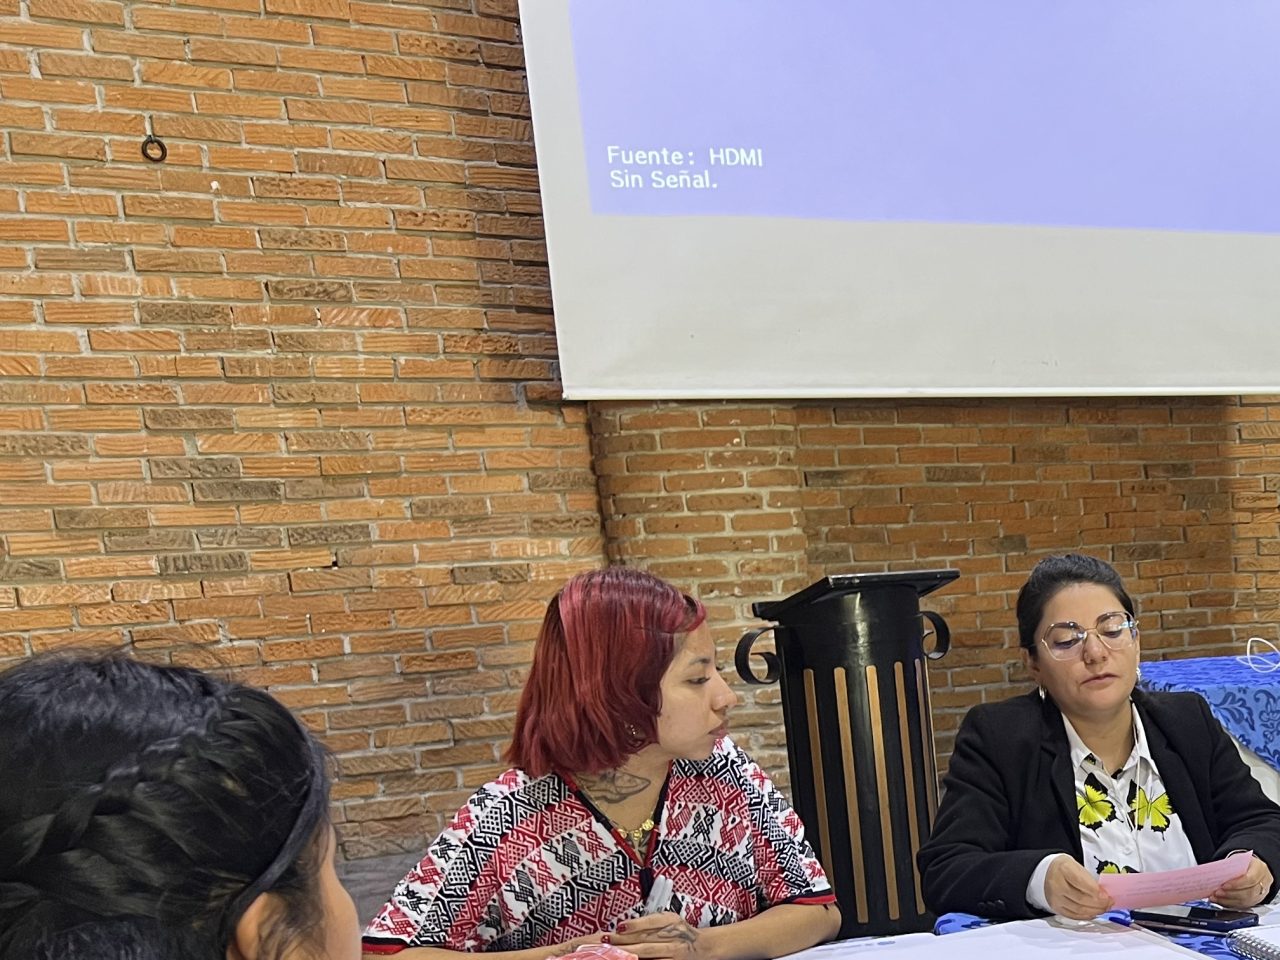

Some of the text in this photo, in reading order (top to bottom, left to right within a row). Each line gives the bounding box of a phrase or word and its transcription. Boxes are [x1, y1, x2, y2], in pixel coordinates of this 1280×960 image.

[709, 148, 763, 166] HDMI
[610, 169, 718, 189] Sin Señal.
